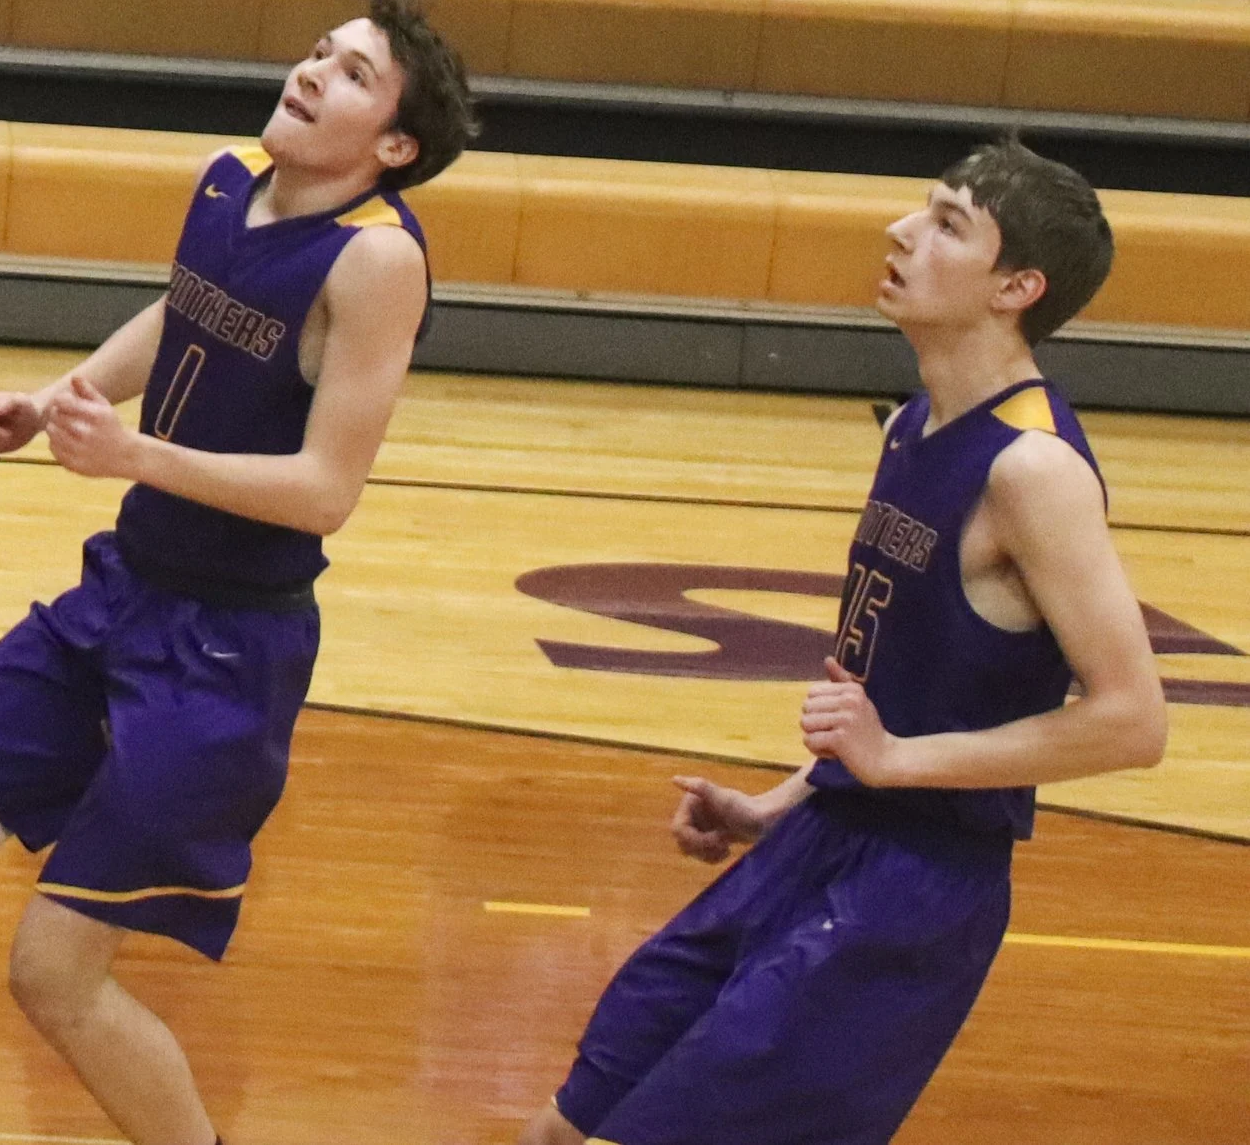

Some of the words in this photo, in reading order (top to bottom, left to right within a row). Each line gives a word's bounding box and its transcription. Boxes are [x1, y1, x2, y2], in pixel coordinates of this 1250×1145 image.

[167, 260, 286, 362] ANTHERS
[154, 343, 206, 442] 1
[835, 563, 893, 684] 15
